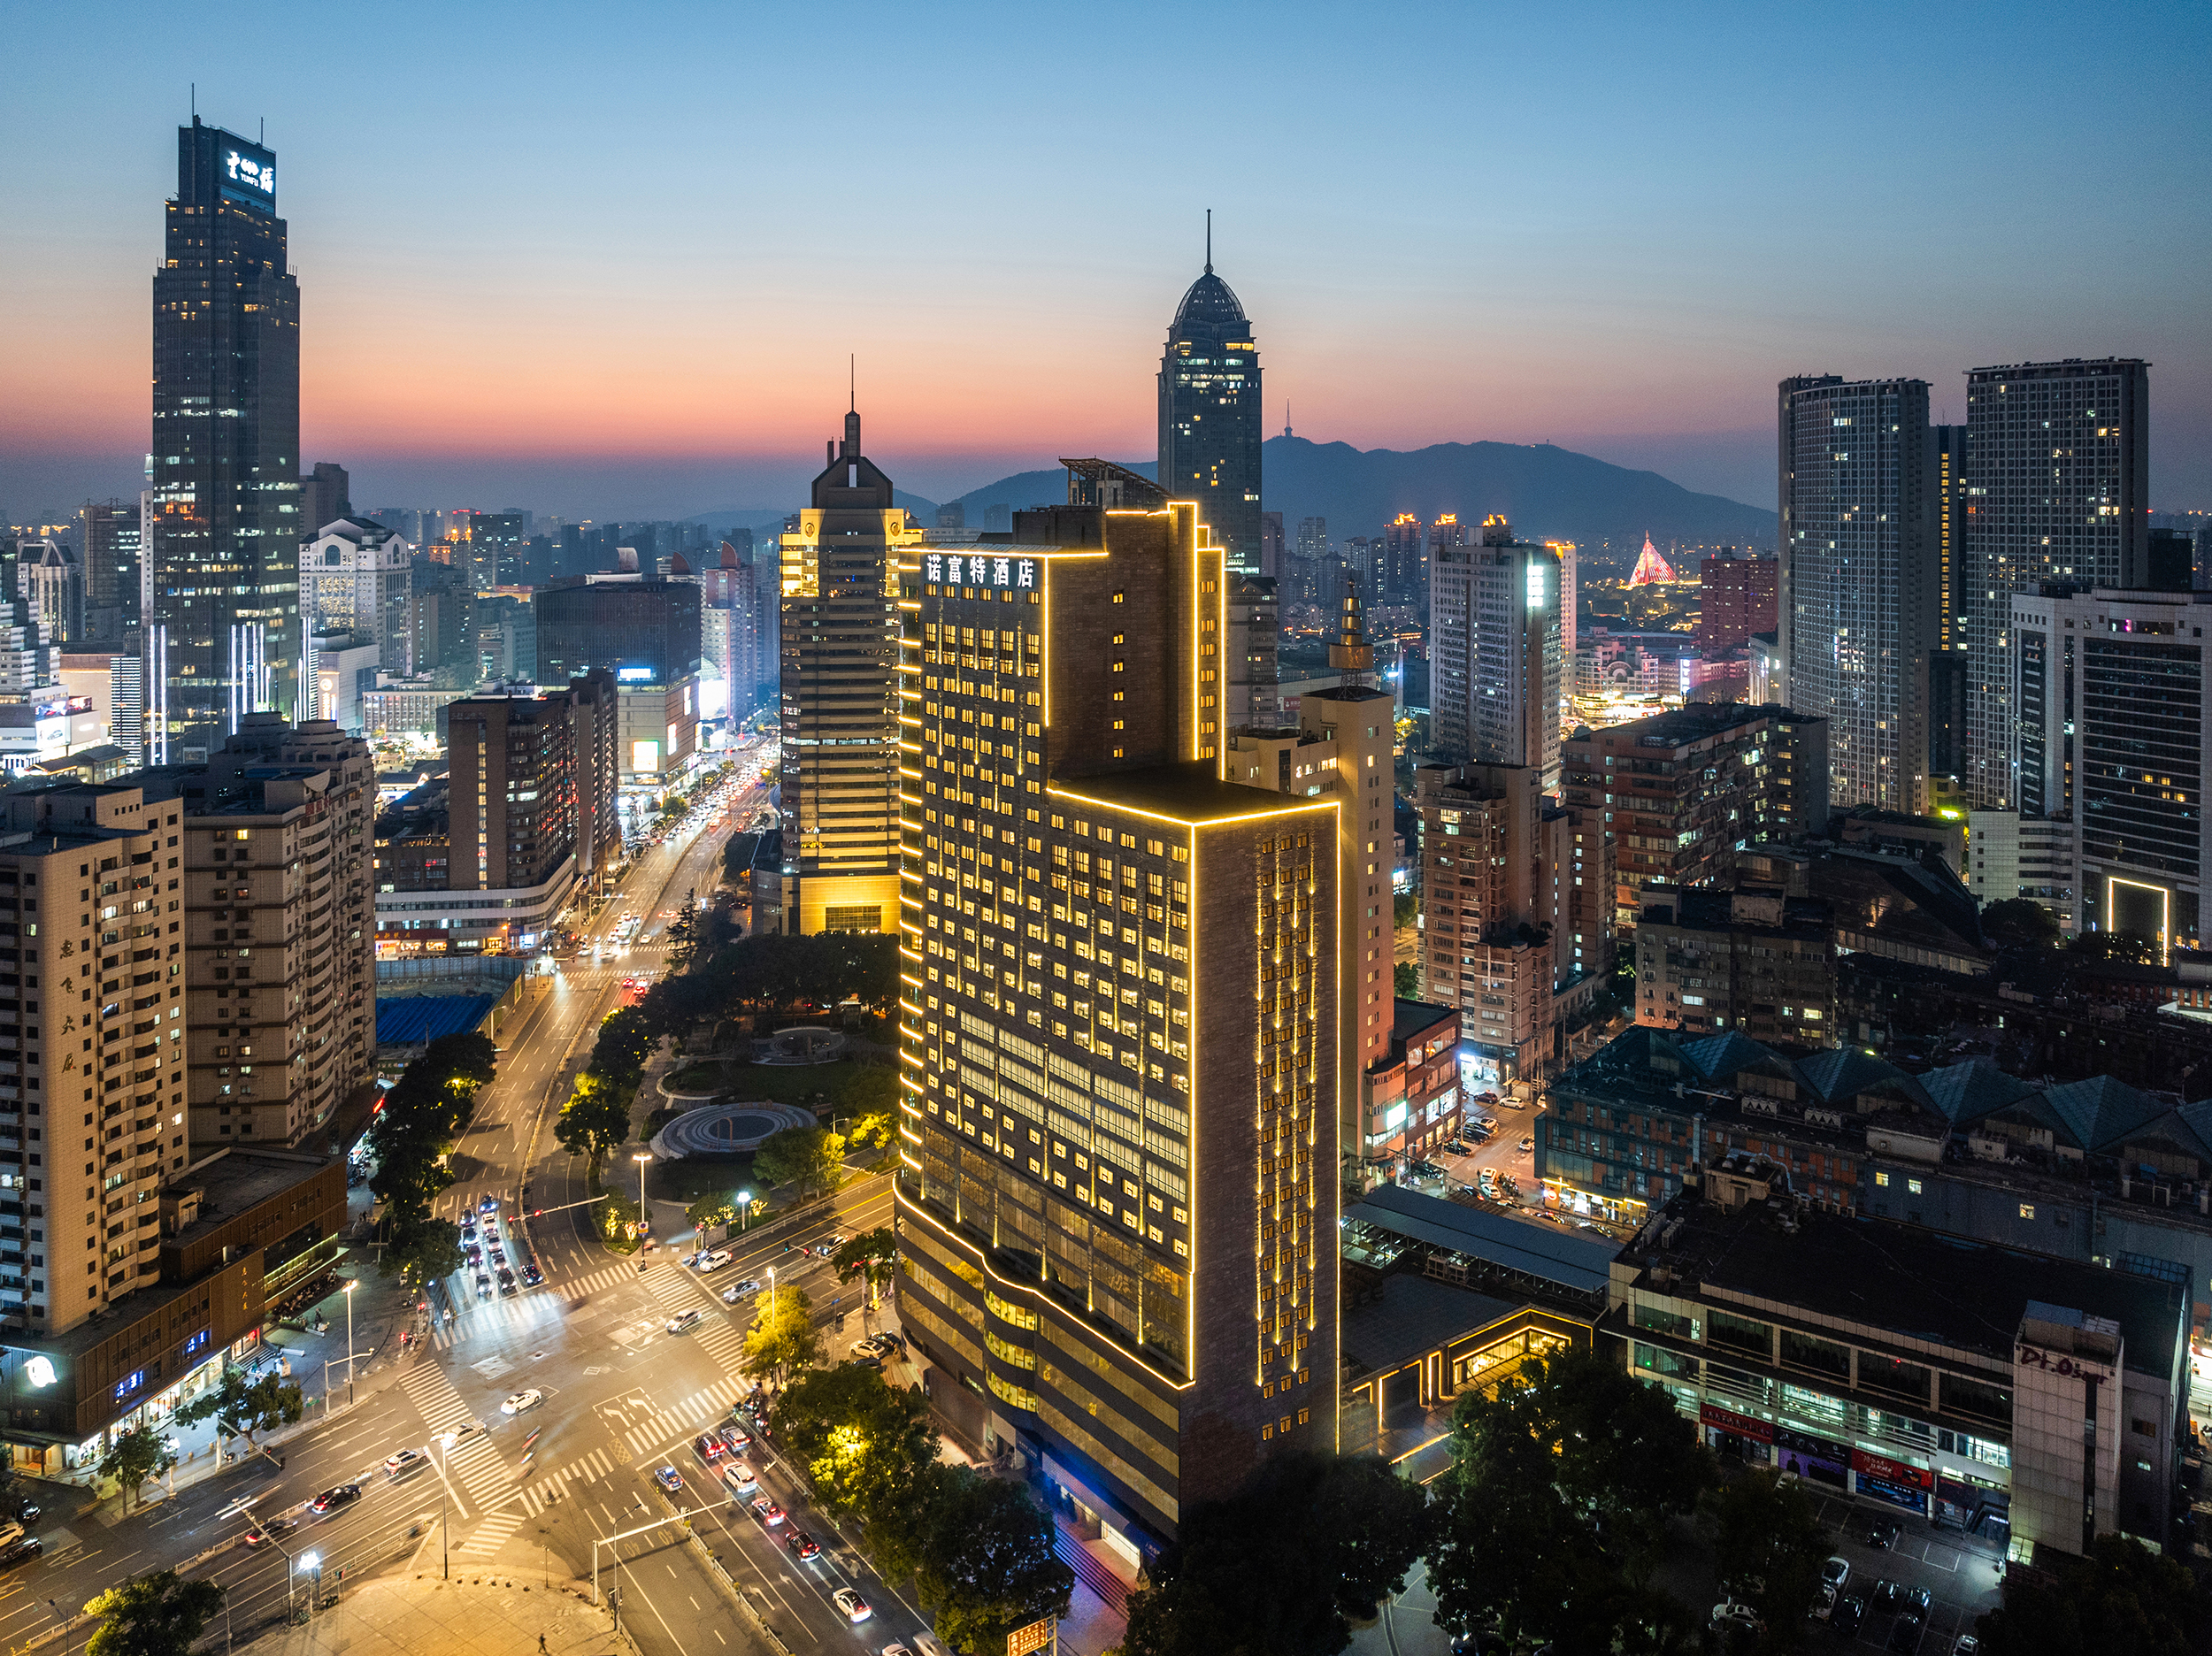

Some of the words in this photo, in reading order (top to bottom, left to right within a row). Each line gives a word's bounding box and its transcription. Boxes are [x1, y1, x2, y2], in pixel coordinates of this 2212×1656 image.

[926, 554, 1034, 587] 诺富特酒店
